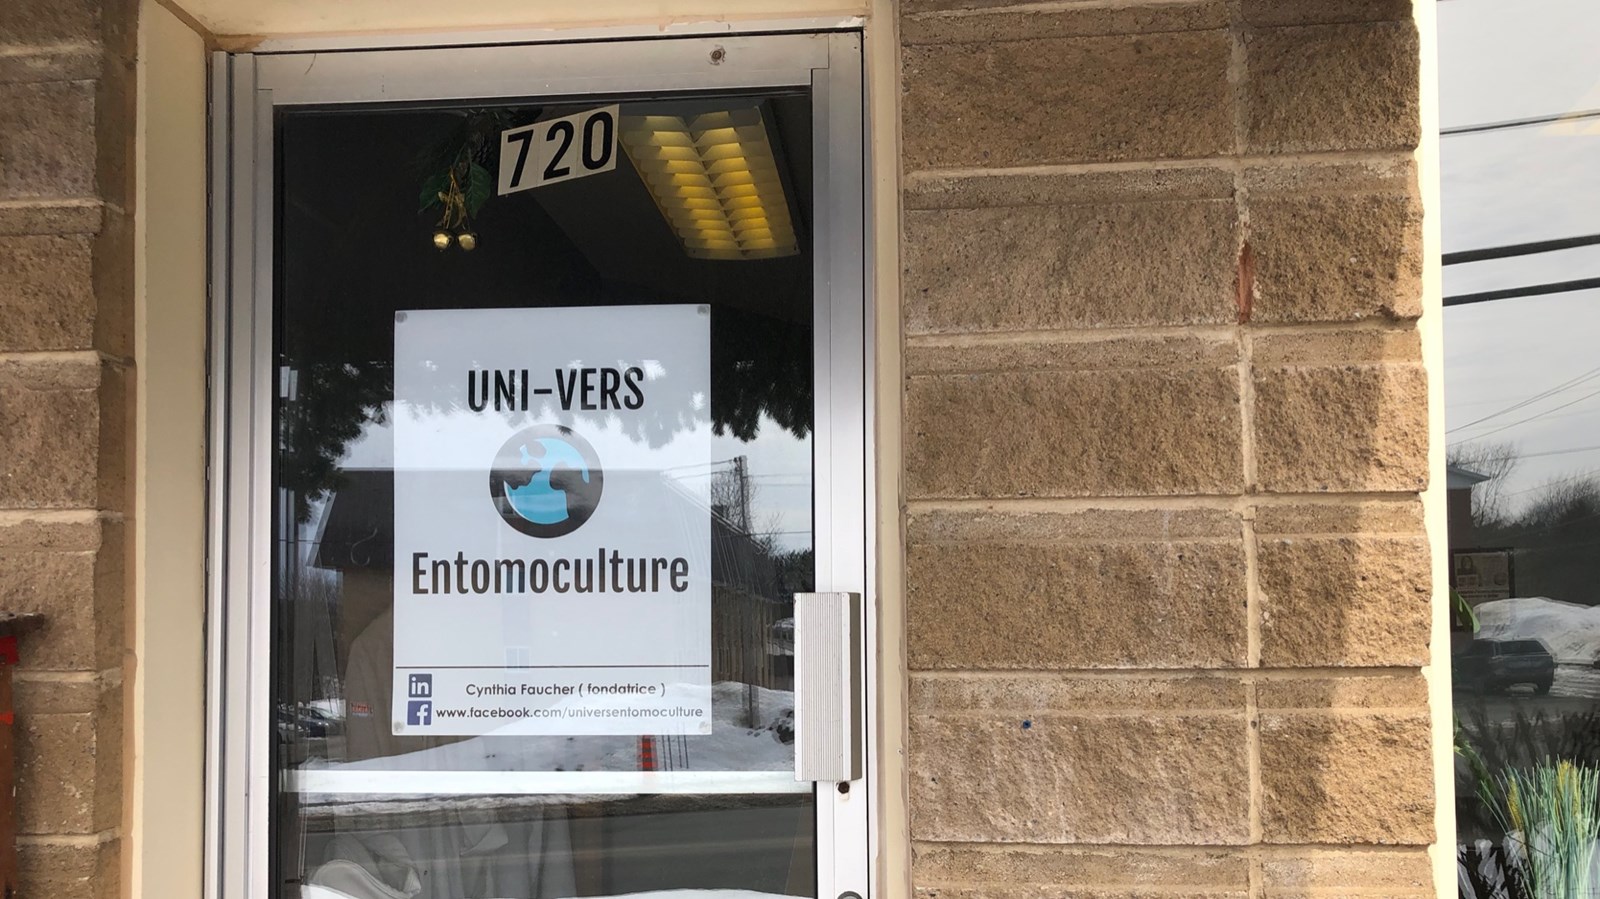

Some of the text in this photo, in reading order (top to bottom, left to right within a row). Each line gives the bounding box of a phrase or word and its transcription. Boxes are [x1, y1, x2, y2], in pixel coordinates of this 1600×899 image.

[507, 111, 614, 189] 720
[467, 366, 645, 413] UNI-VERS
[412, 547, 690, 595] Entomoculture
[411, 676, 430, 695] in
[465, 683, 517, 698] Cynthia
[520, 682, 575, 696] Faucher
[436, 706, 703, 719] www.facebook.com/universentomoculture
